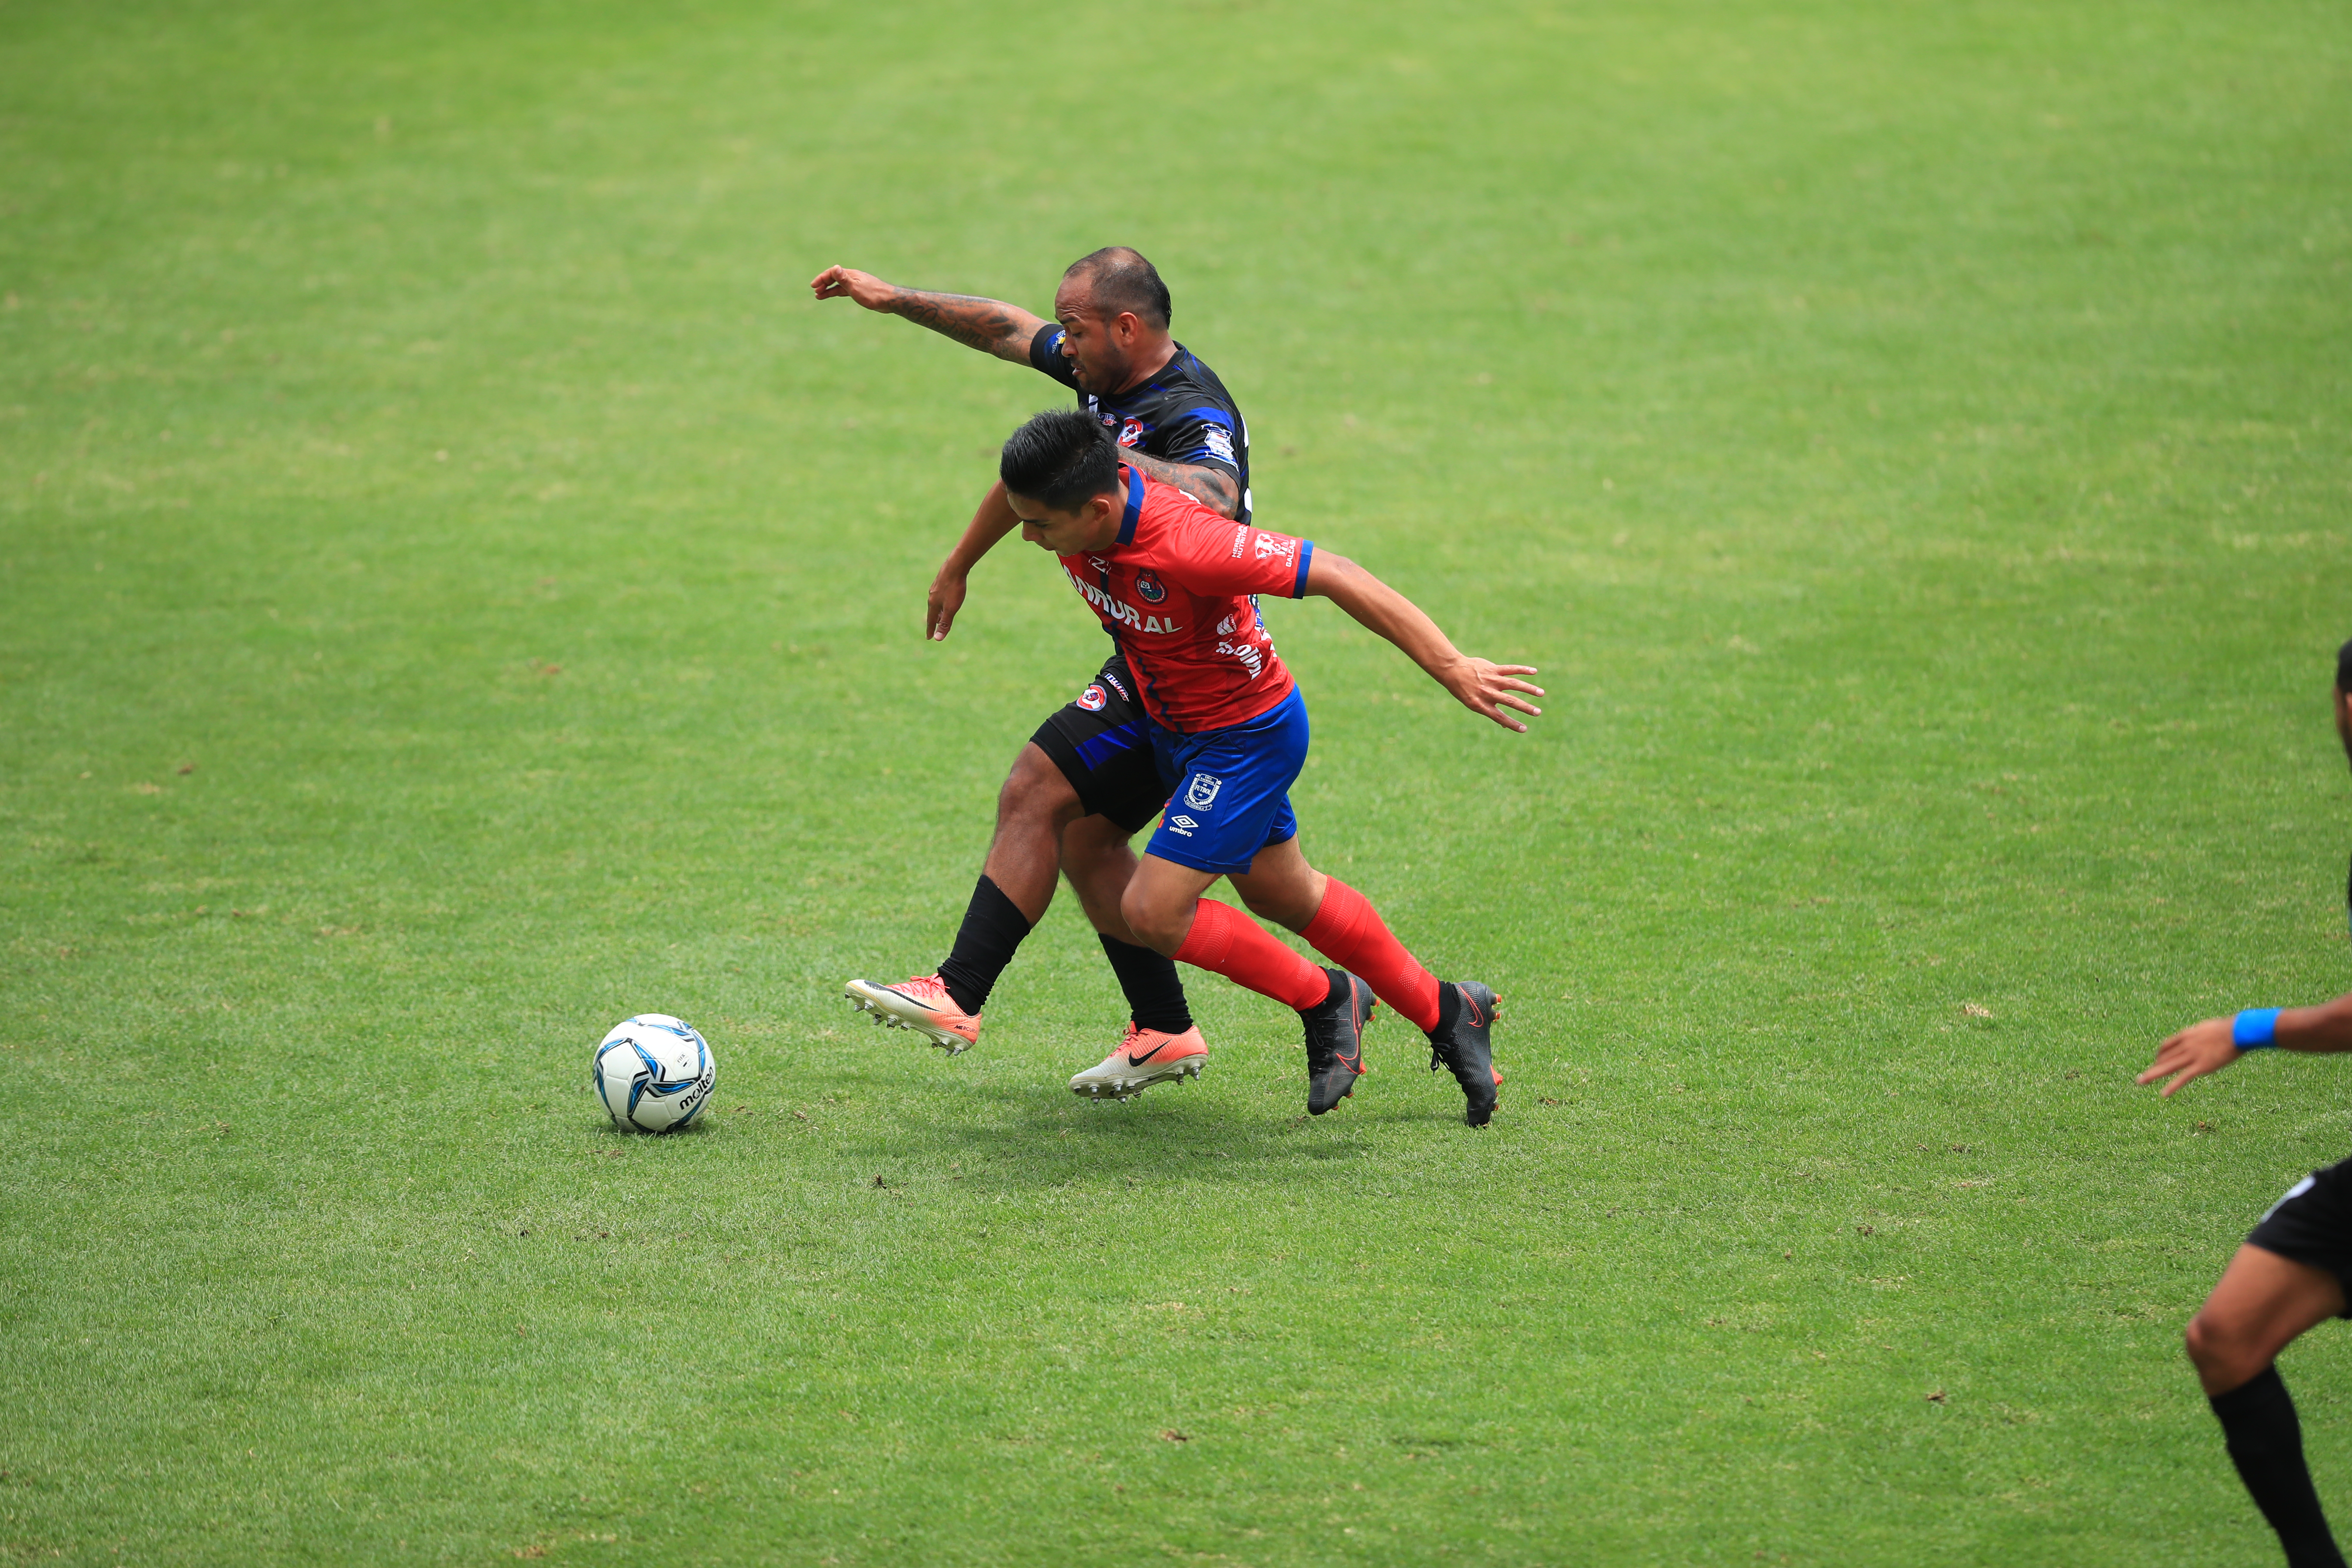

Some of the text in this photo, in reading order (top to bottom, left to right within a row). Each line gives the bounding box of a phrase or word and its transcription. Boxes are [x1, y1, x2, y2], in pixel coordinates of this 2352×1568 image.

[1229, 614, 1237, 631] Chevron
[1195, 785, 1212, 795] FUTBOL
[1169, 826, 1192, 837] umbro
[677, 1054, 685, 1063] FIFA
[679, 1066, 714, 1110] molten
